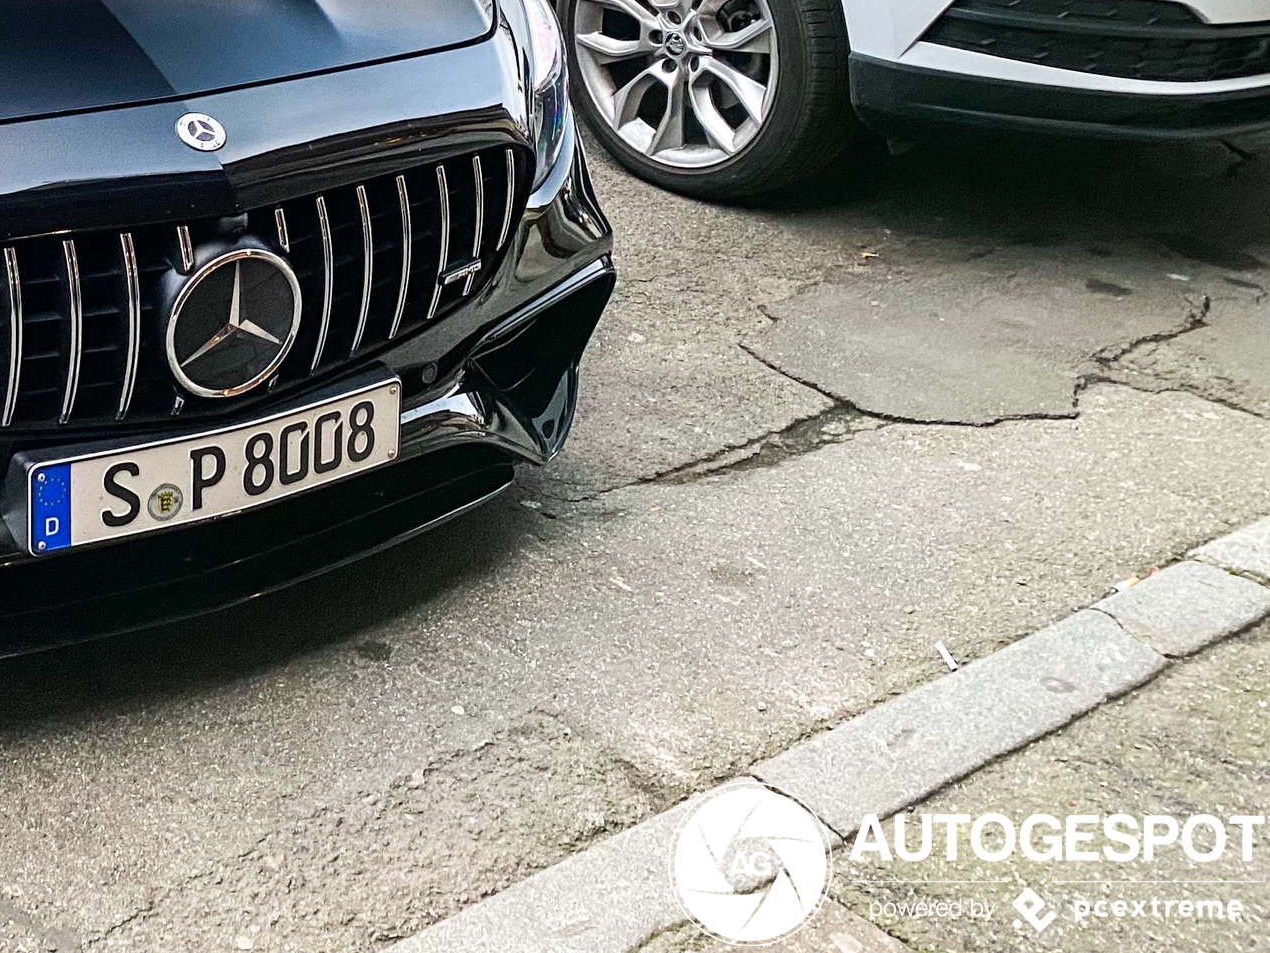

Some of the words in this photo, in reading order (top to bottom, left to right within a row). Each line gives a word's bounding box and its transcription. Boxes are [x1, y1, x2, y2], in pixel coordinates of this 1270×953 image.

[101, 461, 142, 528] S
[190, 445, 227, 511] P
[242, 400, 376, 497] 8008
[45, 516, 61, 537] D
